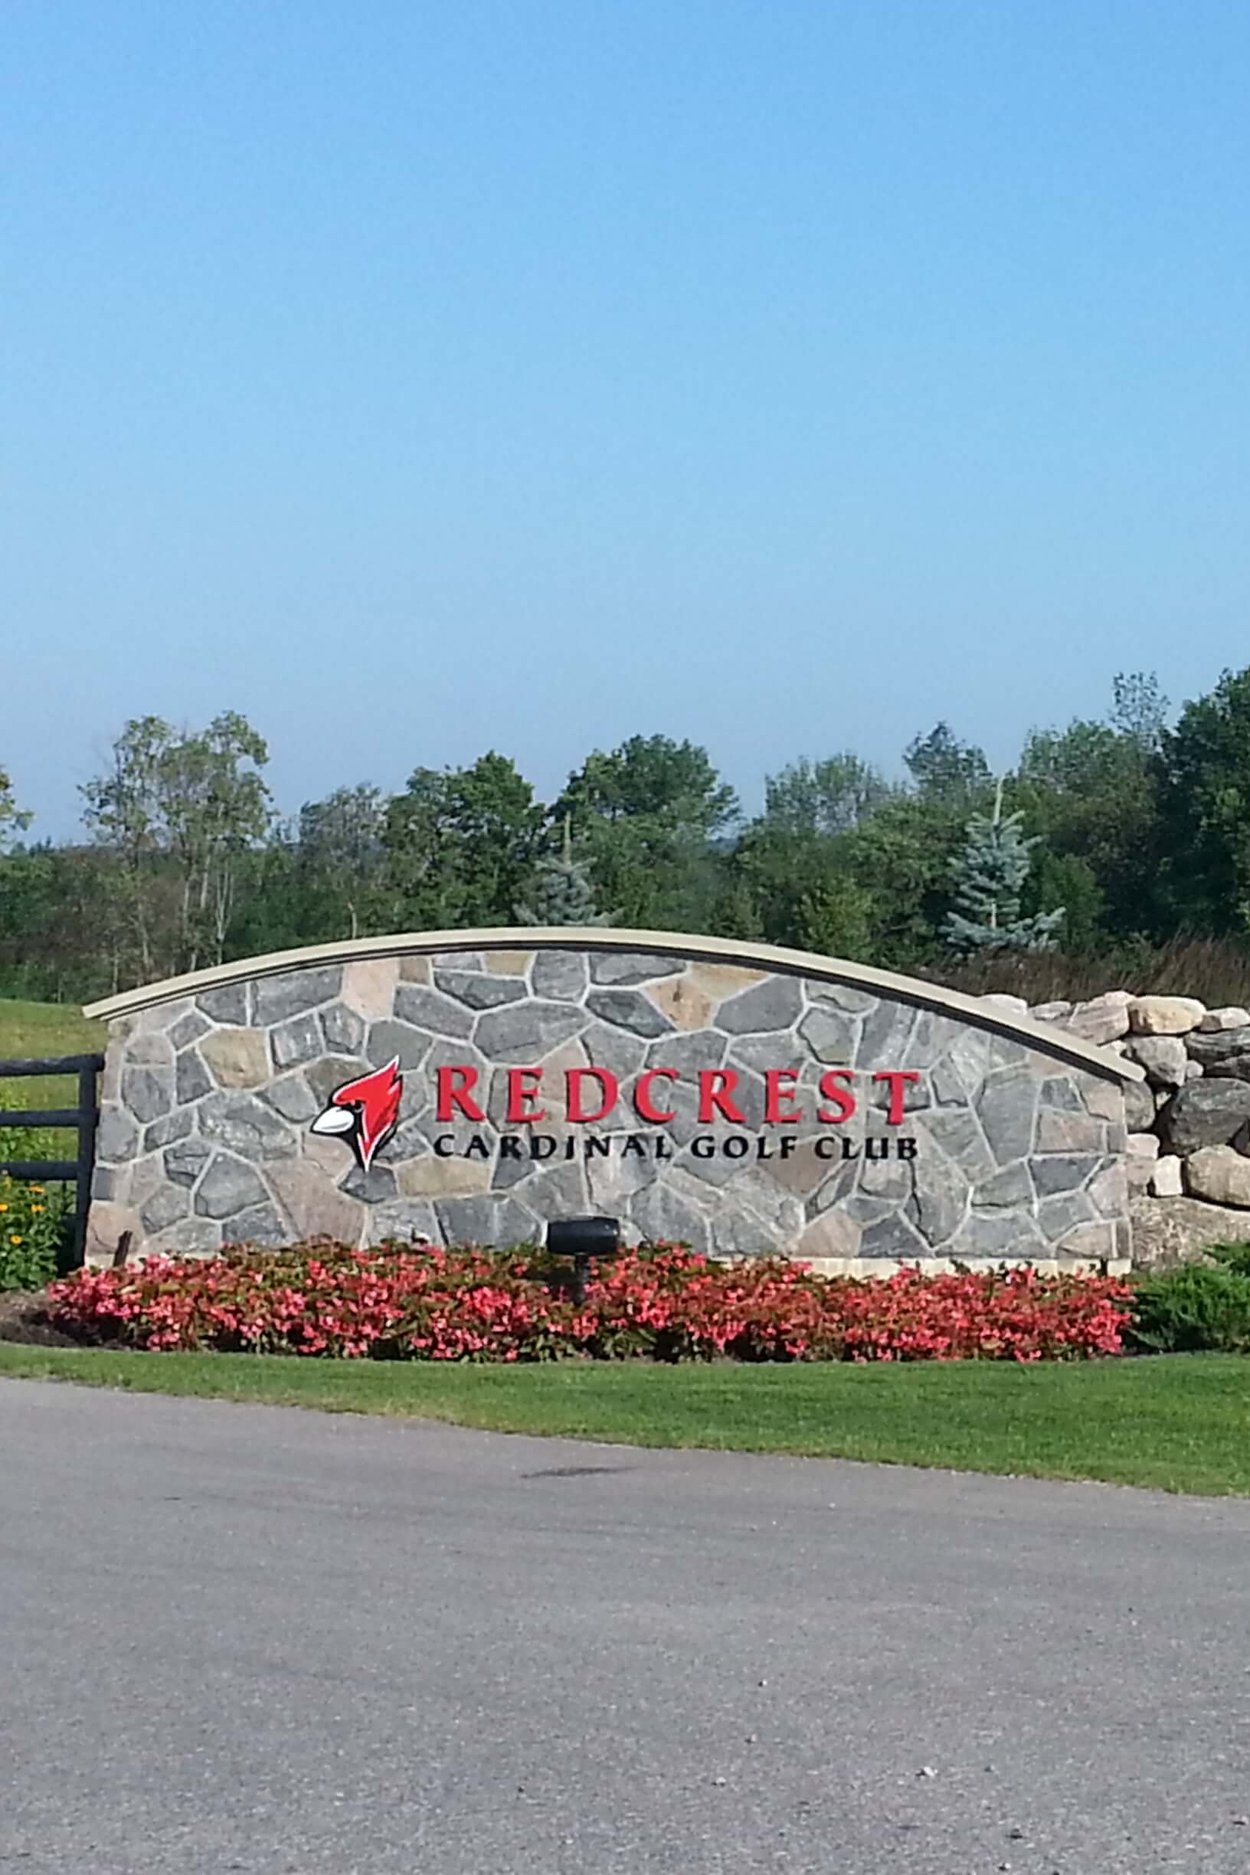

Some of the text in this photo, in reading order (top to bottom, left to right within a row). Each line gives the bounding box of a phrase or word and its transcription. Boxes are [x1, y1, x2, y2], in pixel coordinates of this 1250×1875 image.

[436, 1066, 920, 1125] REDCREST
[433, 1133, 919, 1160] CARDINAL GOLF CLUB
